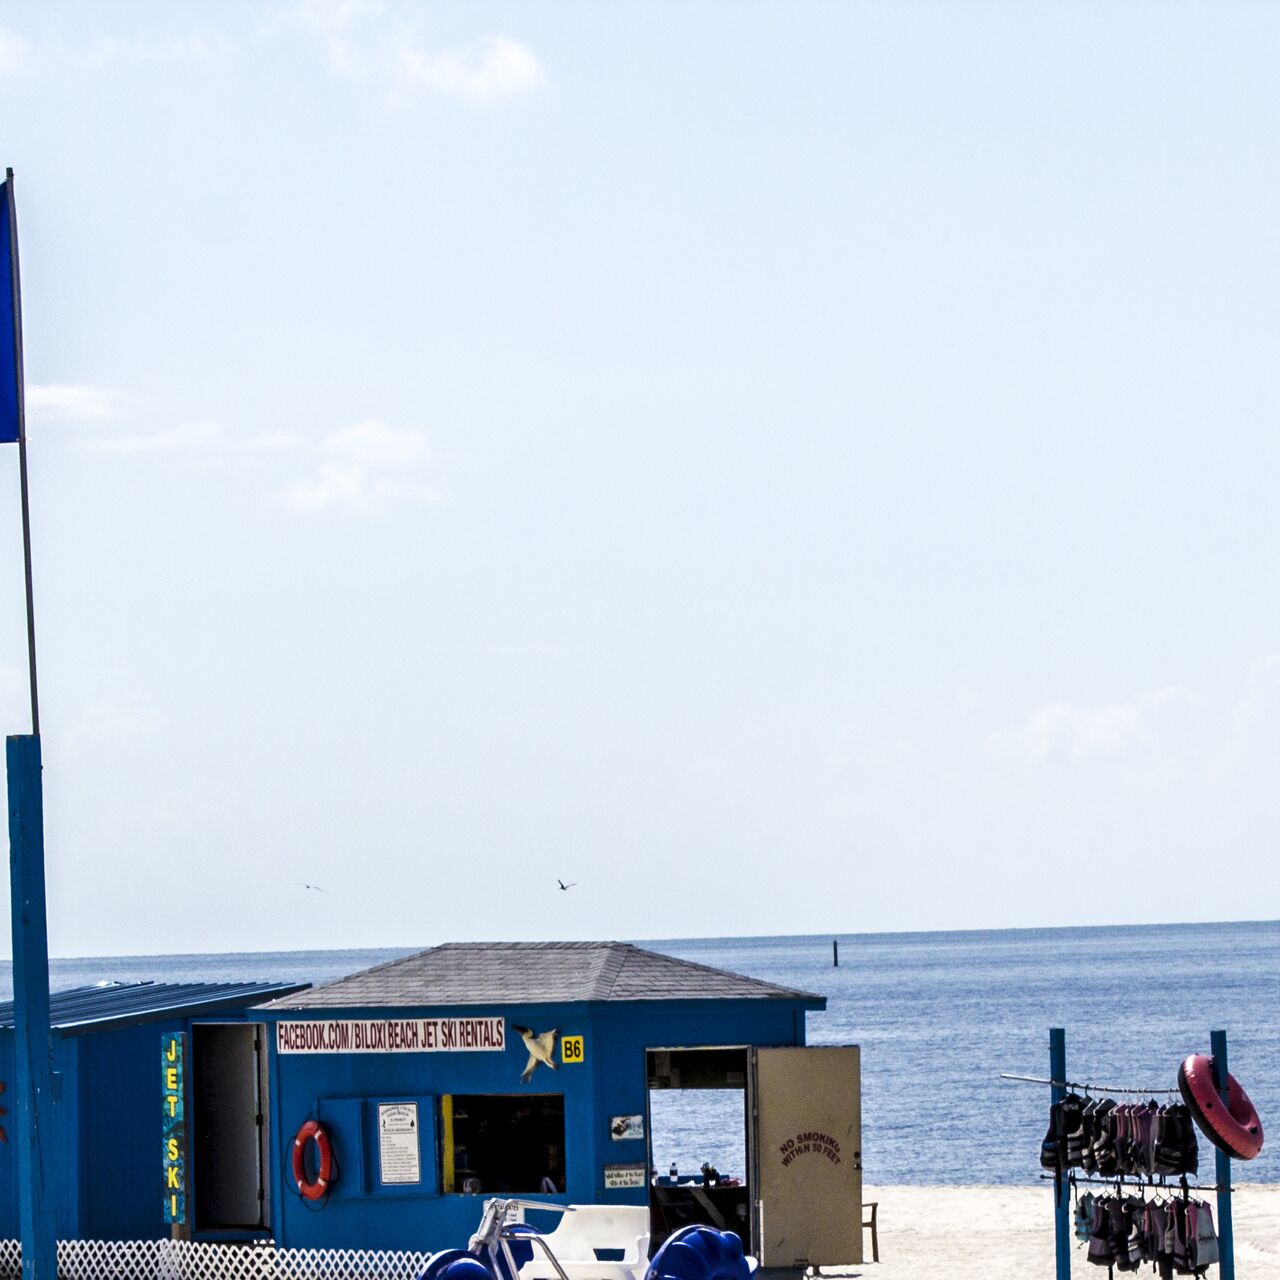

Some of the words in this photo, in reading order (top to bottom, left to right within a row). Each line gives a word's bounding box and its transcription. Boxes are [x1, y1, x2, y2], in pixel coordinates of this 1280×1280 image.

[388, 1021, 419, 1049] BEACH
[421, 1021, 438, 1048] JET
[441, 1020, 458, 1048] SKI
[460, 1019, 504, 1048] RENTALS
[564, 1040, 581, 1058] B6
[166, 1039, 178, 1118] JET
[780, 1139, 795, 1155] NO
[796, 1132, 841, 1153] SMOKING
[781, 1143, 811, 1167] WITHIN
[812, 1143, 823, 1153] 50
[823, 1146, 841, 1165] FEET
[167, 1138, 179, 1217] SKI
